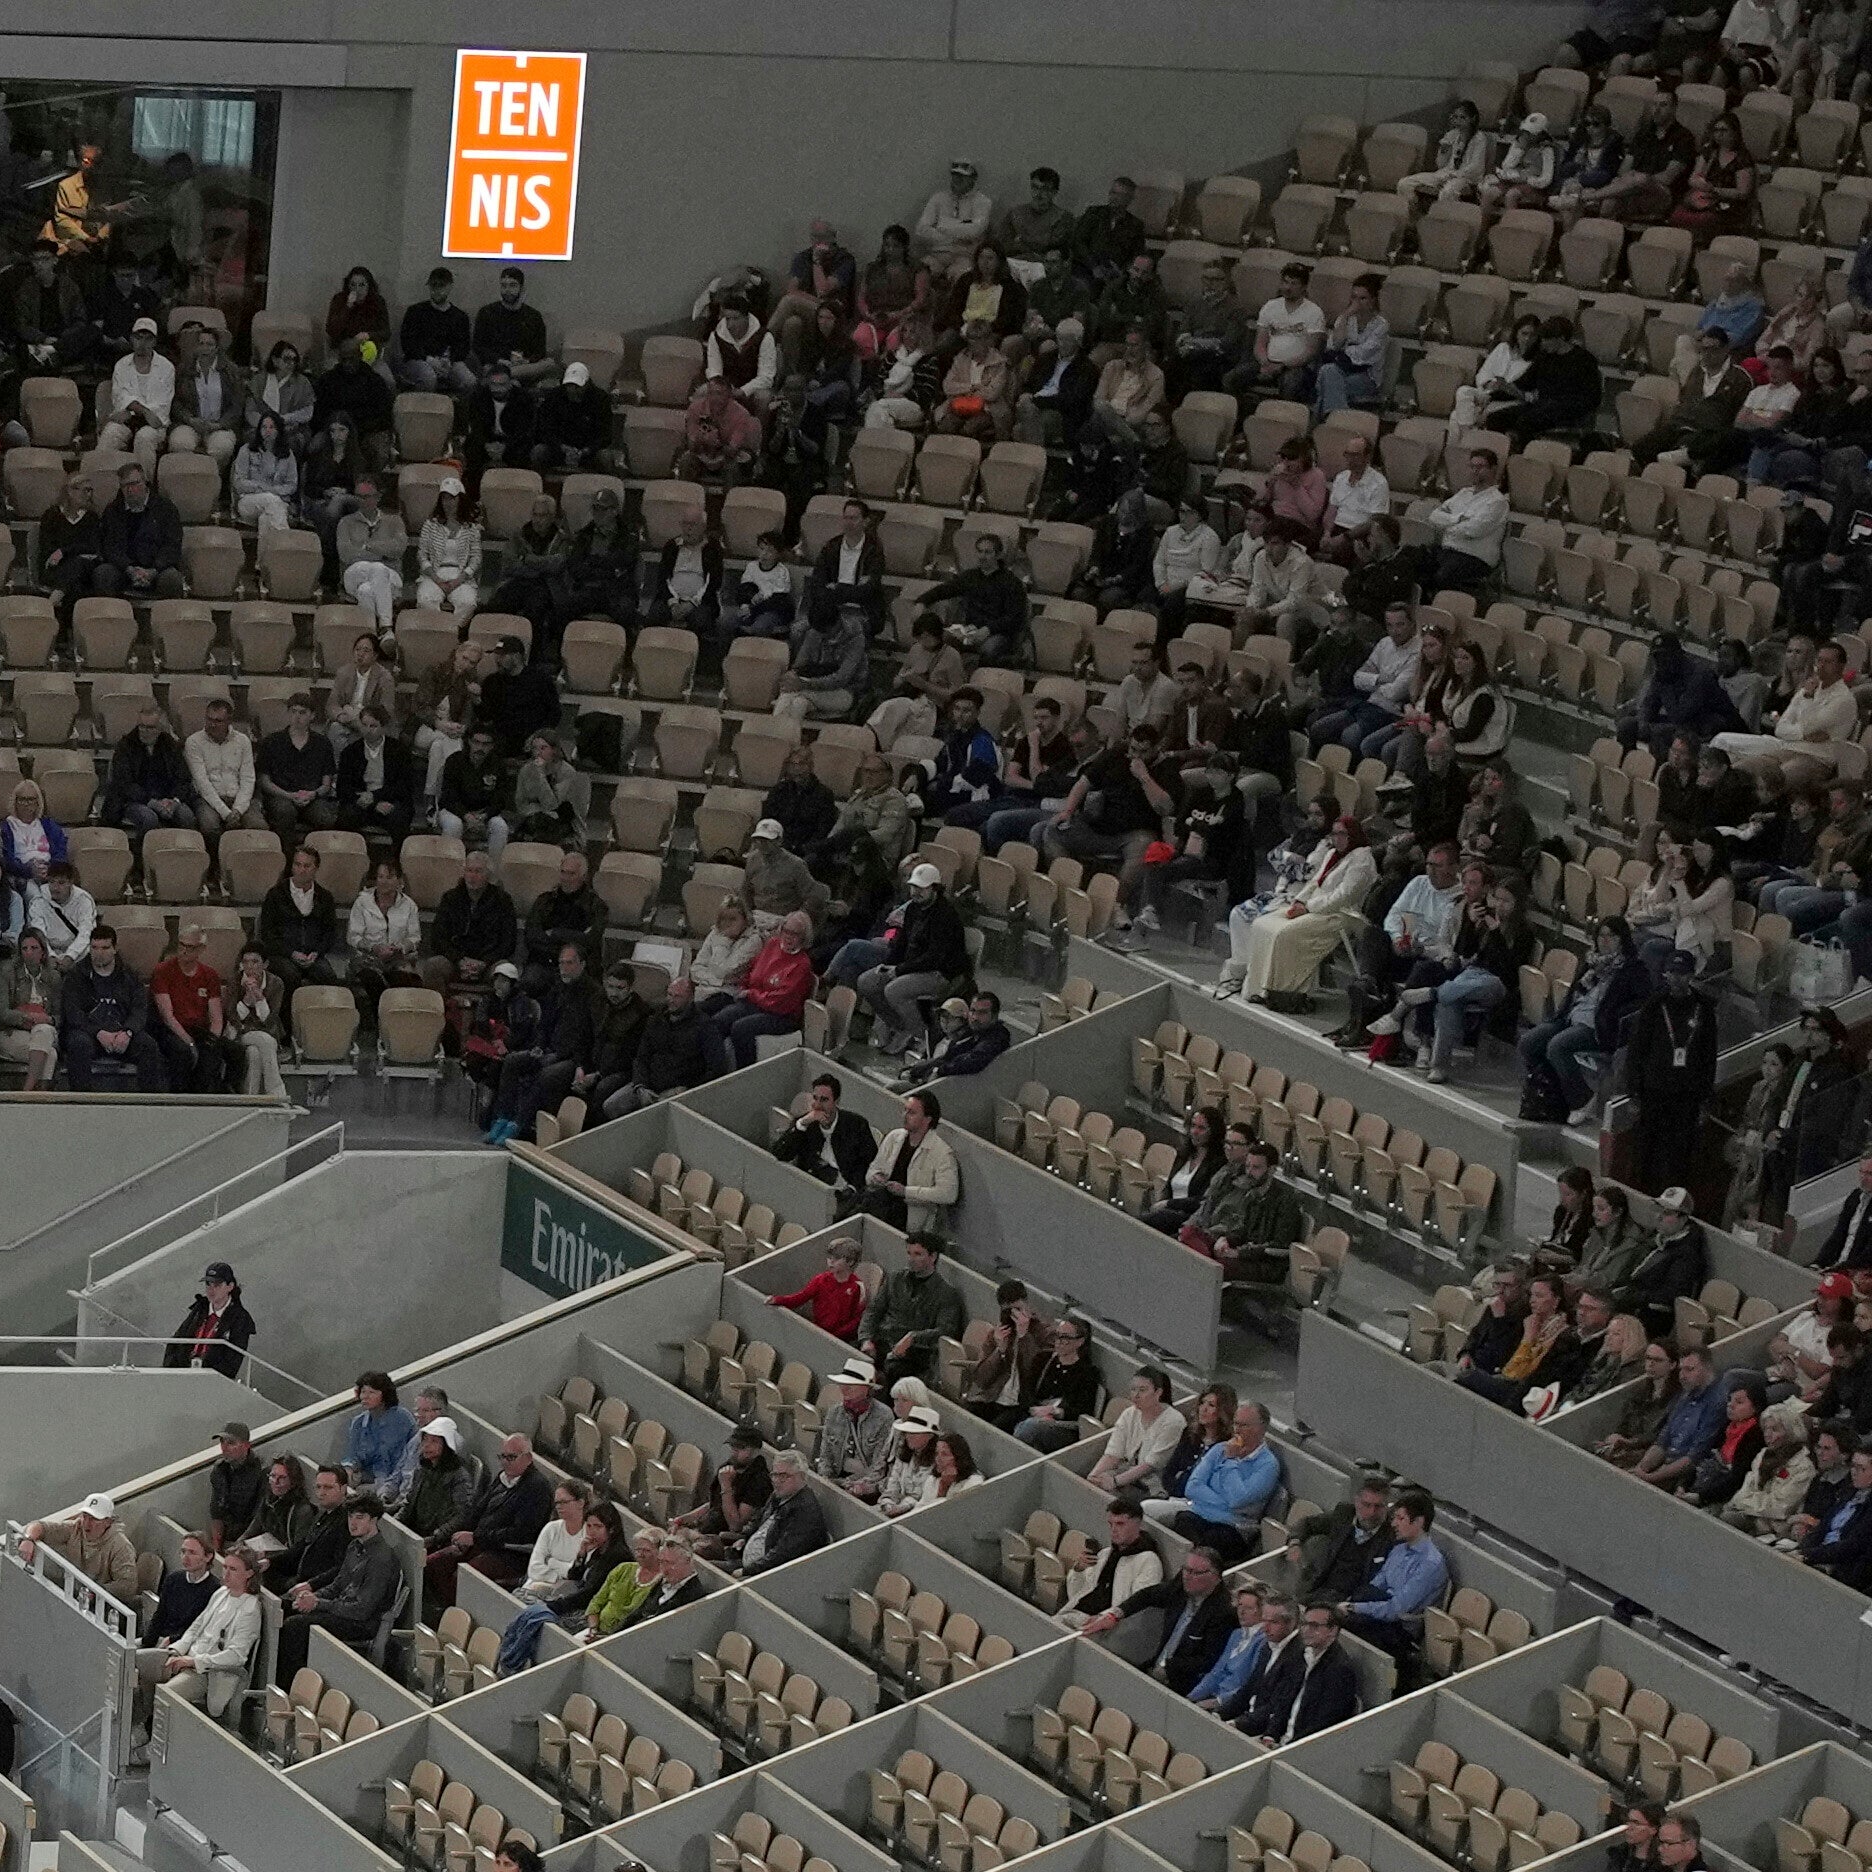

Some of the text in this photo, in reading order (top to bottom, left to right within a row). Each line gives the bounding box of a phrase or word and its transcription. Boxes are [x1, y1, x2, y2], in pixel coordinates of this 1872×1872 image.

[474, 81, 560, 137] TEN
[469, 174, 551, 230] NIS
[531, 1197, 634, 1292] Emirat
